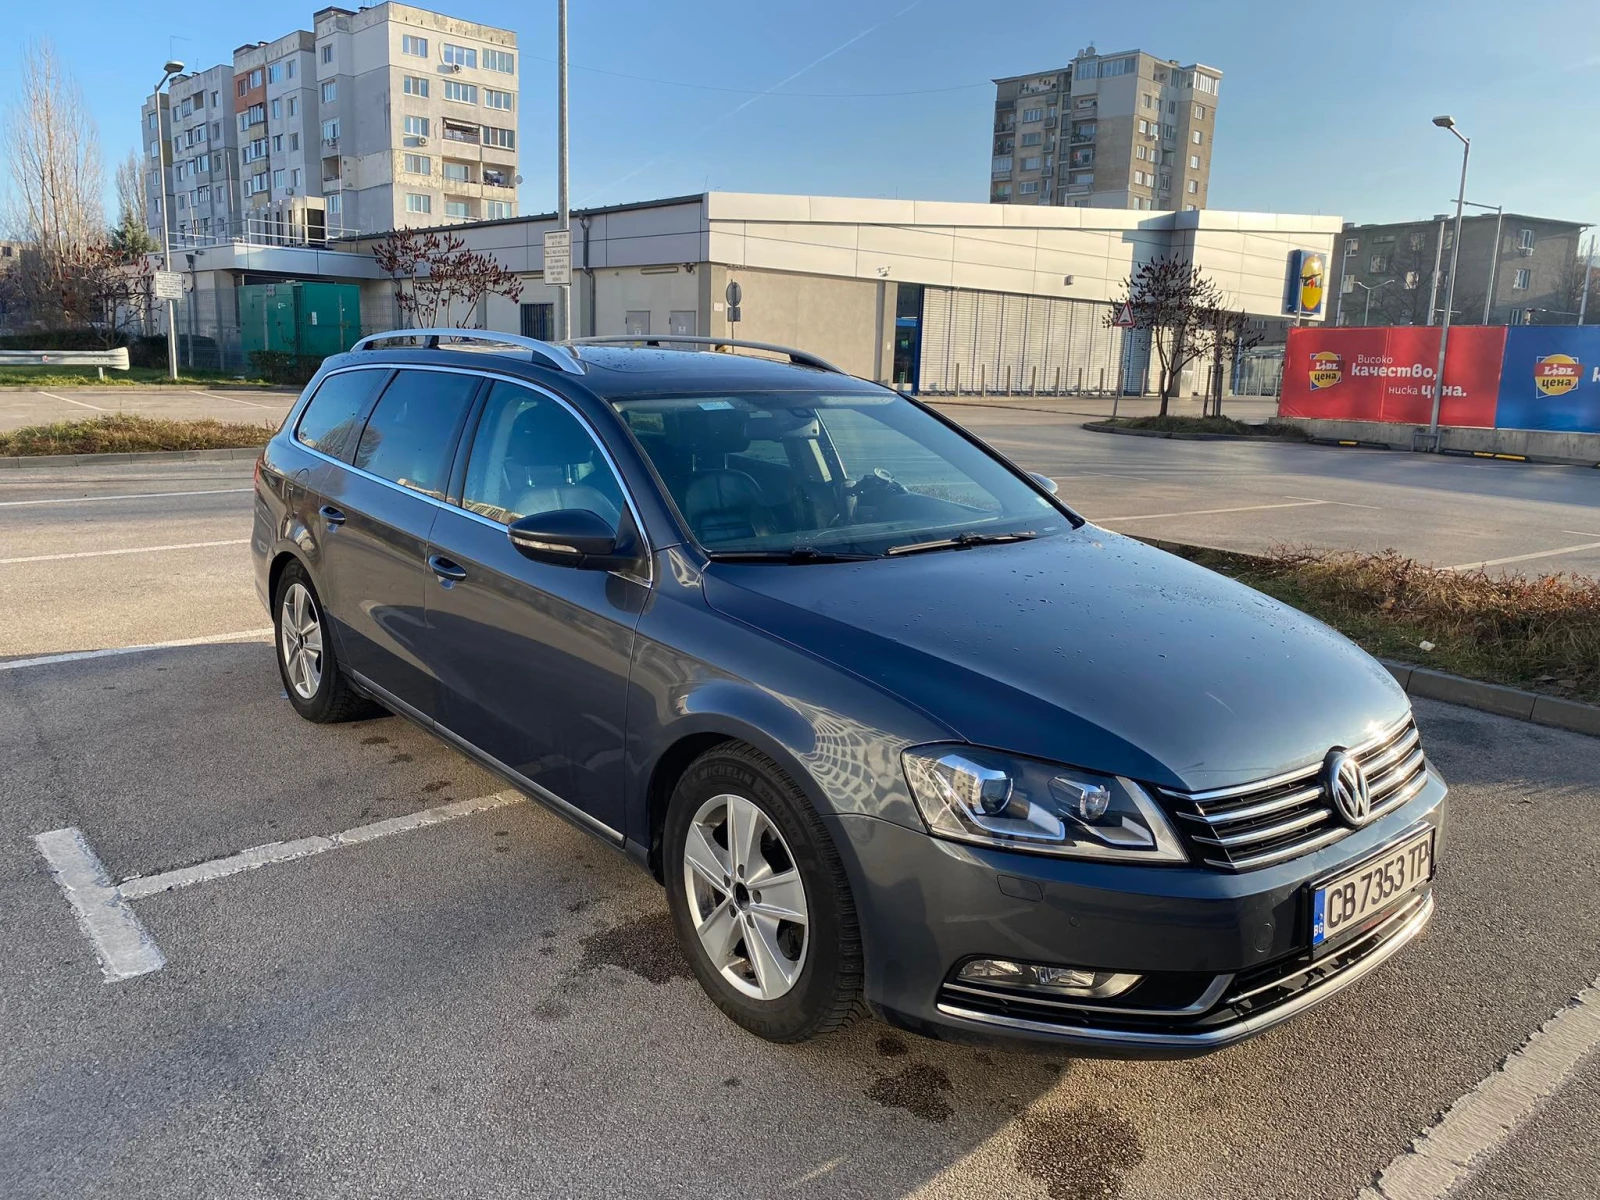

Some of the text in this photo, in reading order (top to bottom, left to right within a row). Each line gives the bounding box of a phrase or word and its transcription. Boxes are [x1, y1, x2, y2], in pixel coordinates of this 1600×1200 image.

[1358, 355, 1393, 364] Високо
[1314, 372, 1337, 382] цена
[1351, 363, 1437, 381] качество,
[1542, 379, 1571, 389] цена
[1388, 385, 1418, 395] ниска
[1313, 922, 1324, 937] BG
